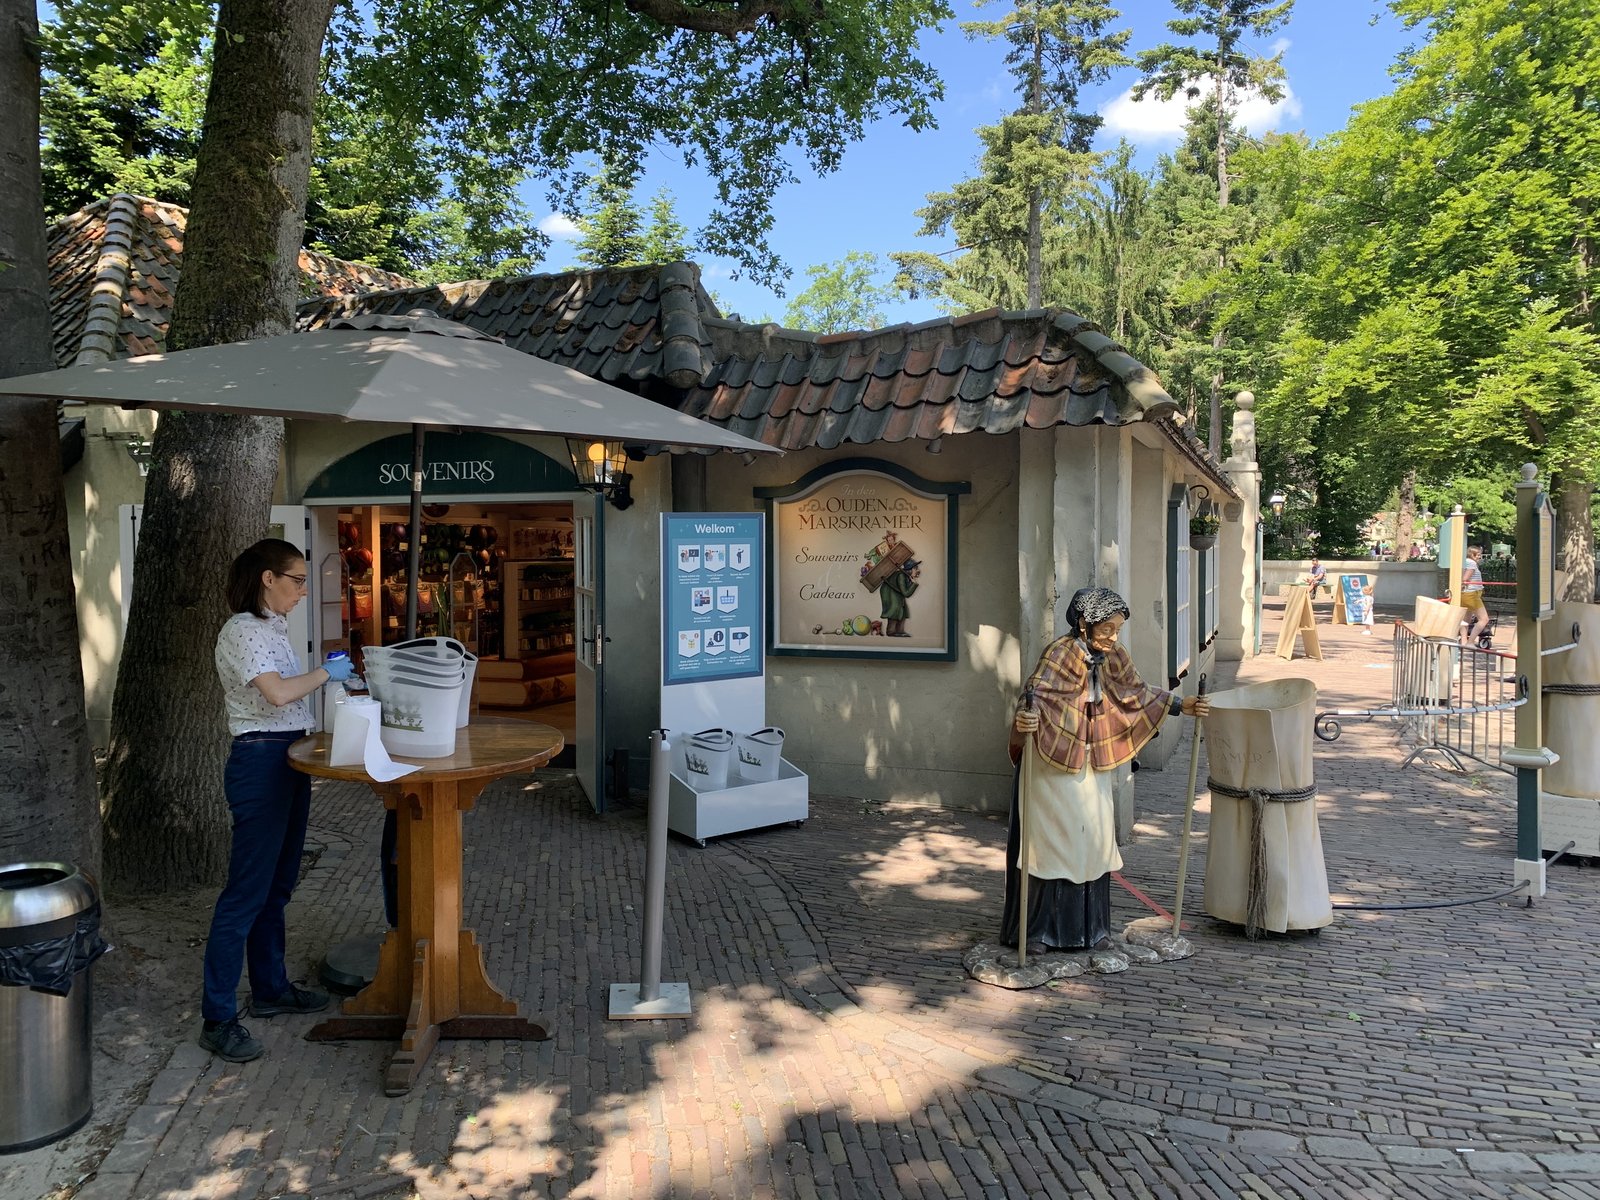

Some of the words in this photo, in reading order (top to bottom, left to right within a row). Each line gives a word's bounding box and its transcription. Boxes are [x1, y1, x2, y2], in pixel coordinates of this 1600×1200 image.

[856, 484, 876, 496] den
[826, 497, 890, 513] OUDEN
[694, 523, 735, 534] Welkom
[798, 514, 924, 533] MARSKRAMER
[795, 547, 860, 564] Souvenirs
[799, 584, 856, 601] Cadeaus
